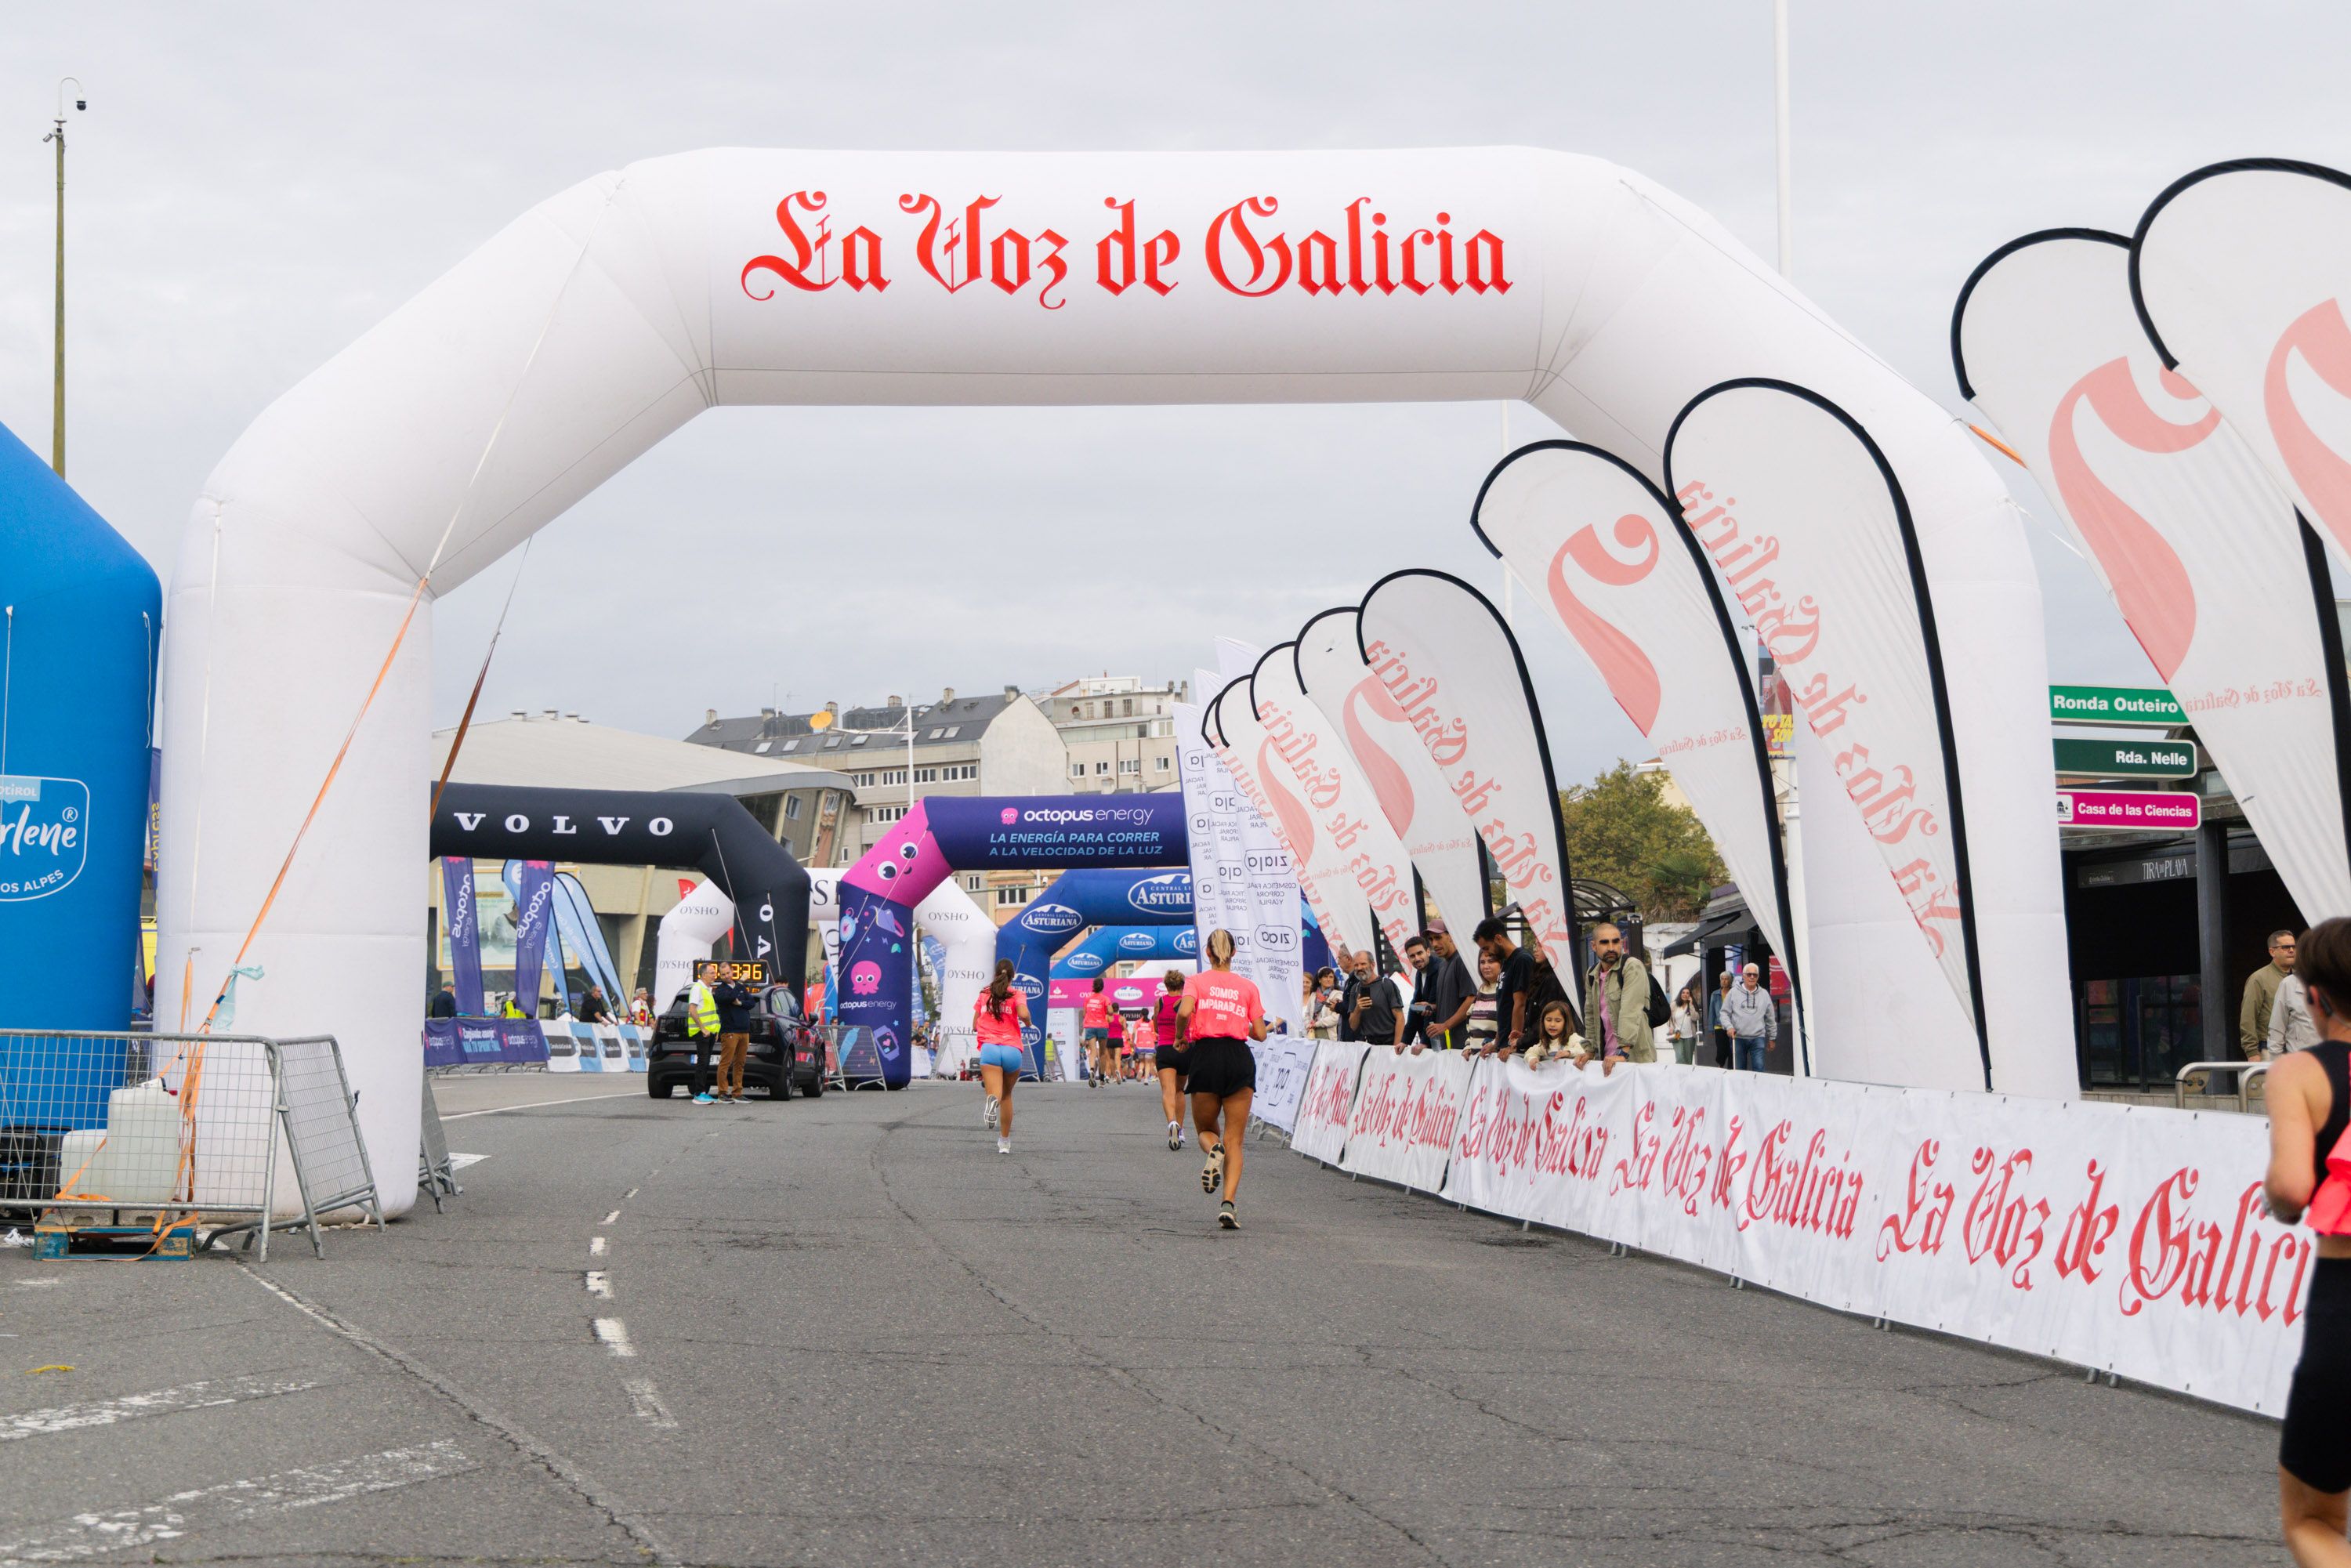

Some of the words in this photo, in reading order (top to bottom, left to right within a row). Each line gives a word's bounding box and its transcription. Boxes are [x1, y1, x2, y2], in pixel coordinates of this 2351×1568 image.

[741, 190, 892, 301] La
[898, 194, 1069, 310] Voz
[1096, 197, 1180, 297] de
[1204, 195, 1513, 297] Galicia
[2053, 694, 2108, 711] Ronda
[2114, 697, 2178, 713] Outeiro
[2115, 750, 2146, 764] Rda.
[2151, 751, 2187, 766] Nelle
[1023, 809, 1093, 824] octopus
[1095, 809, 1154, 825] energy
[2078, 802, 2106, 815] Casa
[2108, 803, 2123, 816] de
[2125, 804, 2142, 817] las
[2144, 805, 2193, 817] Ciencias
[454, 812, 674, 836] VOLVO
[990, 833, 1006, 843] LA
[1010, 831, 1065, 843] ENERGÍA
[1069, 832, 1104, 843] PARA
[1107, 831, 1160, 842] CORRER
[989, 847, 998, 856] A
[1002, 847, 1018, 856] LA
[1022, 847, 1095, 856] VELOCIDAD
[1098, 846, 1115, 855] DE
[1118, 846, 1135, 855] LA
[1138, 846, 1163, 854] LUZ
[0, 882, 19, 893] OS
[24, 869, 63, 892] ALPES
[1136, 886, 1193, 904] ASTURI
[679, 906, 719, 915] OYSHO
[929, 911, 969, 922] OYSHO
[1025, 914, 1078, 926] ASTURIANA
[1121, 938, 1153, 947] ASTURIANA
[1070, 958, 1101, 966] ASTURIANA
[947, 969, 985, 980] OYSHO
[1209, 986, 1240, 1001] SOMOS
[868, 1001, 897, 1010] energy
[1198, 999, 1246, 1018] IMPARABLES
[1610, 1099, 1661, 1197] La
[1662, 1105, 1712, 1217] Voz
[1711, 1114, 1747, 1210] de
[1736, 1118, 1864, 1241] Galicia
[1875, 1138, 1955, 1262] La
[1963, 1146, 2052, 1291] Voz
[2053, 1157, 2119, 1286] de
[2118, 1166, 2311, 1329] Galici
